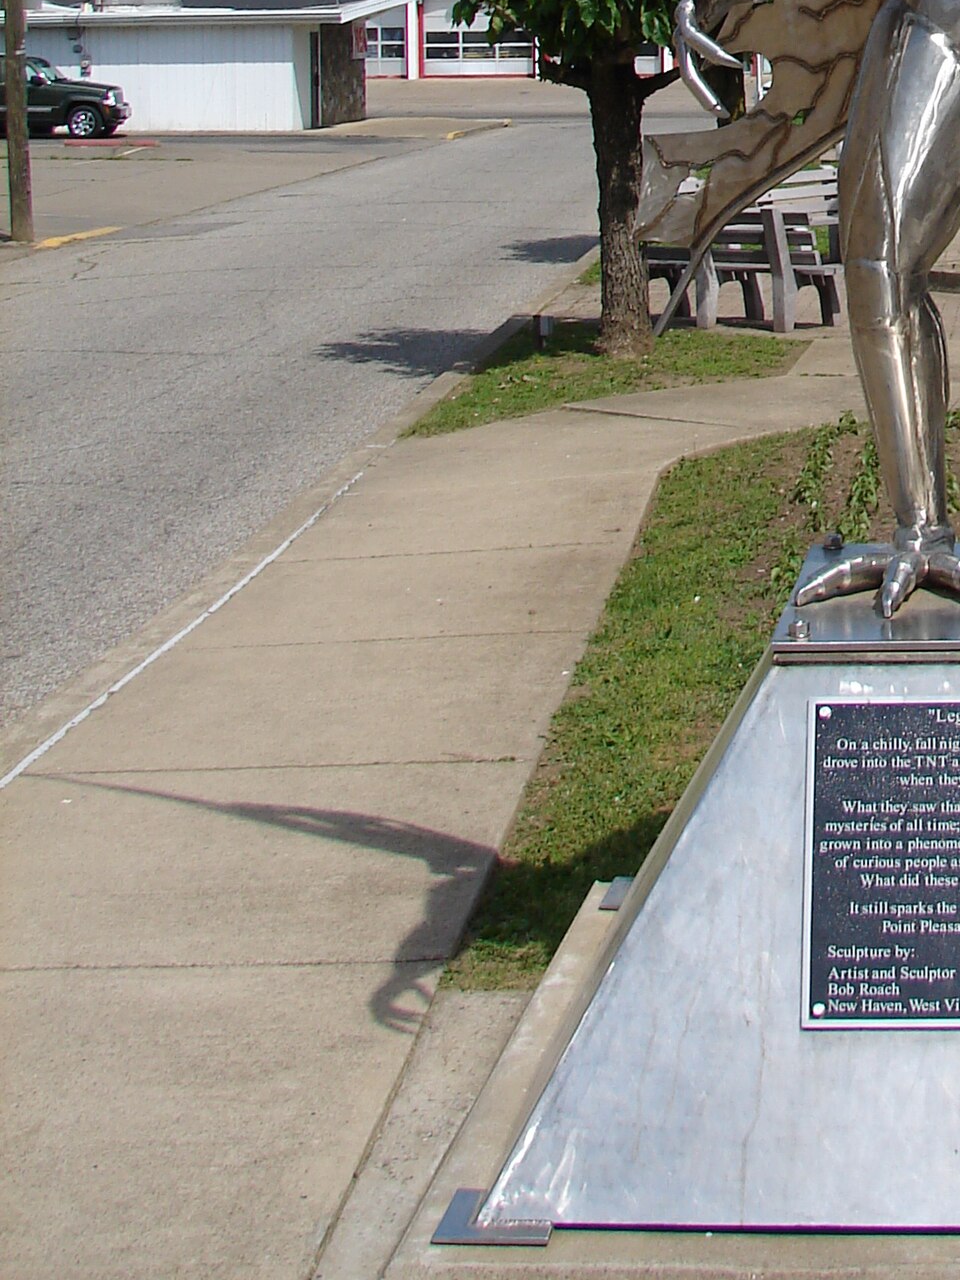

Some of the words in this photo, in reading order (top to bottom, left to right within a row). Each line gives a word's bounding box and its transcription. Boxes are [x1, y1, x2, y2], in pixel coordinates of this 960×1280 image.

[837, 739, 856, 750] On
[862, 740, 869, 750] a
[916, 738, 936, 749] fall
[823, 756, 857, 768] drove
[862, 756, 887, 768] into
[891, 756, 911, 767] the
[915, 755, 948, 767] TNT
[900, 774, 933, 785] when
[842, 801, 877, 813] What
[881, 800, 909, 815] they
[912, 803, 937, 812] saw
[825, 820, 886, 833] mysteries
[890, 820, 904, 831] of
[906, 819, 922, 831] all
[820, 840, 860, 852] grown
[866, 838, 892, 850] into
[896, 840, 903, 849] a
[835, 856, 849, 868] of
[853, 856, 900, 868] curious
[905, 855, 947, 870] people
[861, 874, 895, 887] What
[899, 874, 920, 886] did
[924, 874, 958, 886] these
[850, 902, 859, 914] It
[862, 902, 888, 914] still
[890, 902, 933, 916] sparks
[937, 902, 956, 913] the
[883, 921, 916, 932] Point
[828, 945, 891, 960] Sculpture
[895, 945, 915, 960] by:
[828, 967, 869, 979] Artist
[872, 967, 896, 979] and
[900, 967, 956, 982] Sculptor
[828, 983, 854, 996] Bob
[860, 983, 900, 995] Roach
[828, 1000, 857, 1012] New
[862, 999, 906, 1013] Haven,
[909, 999, 940, 1011] West
